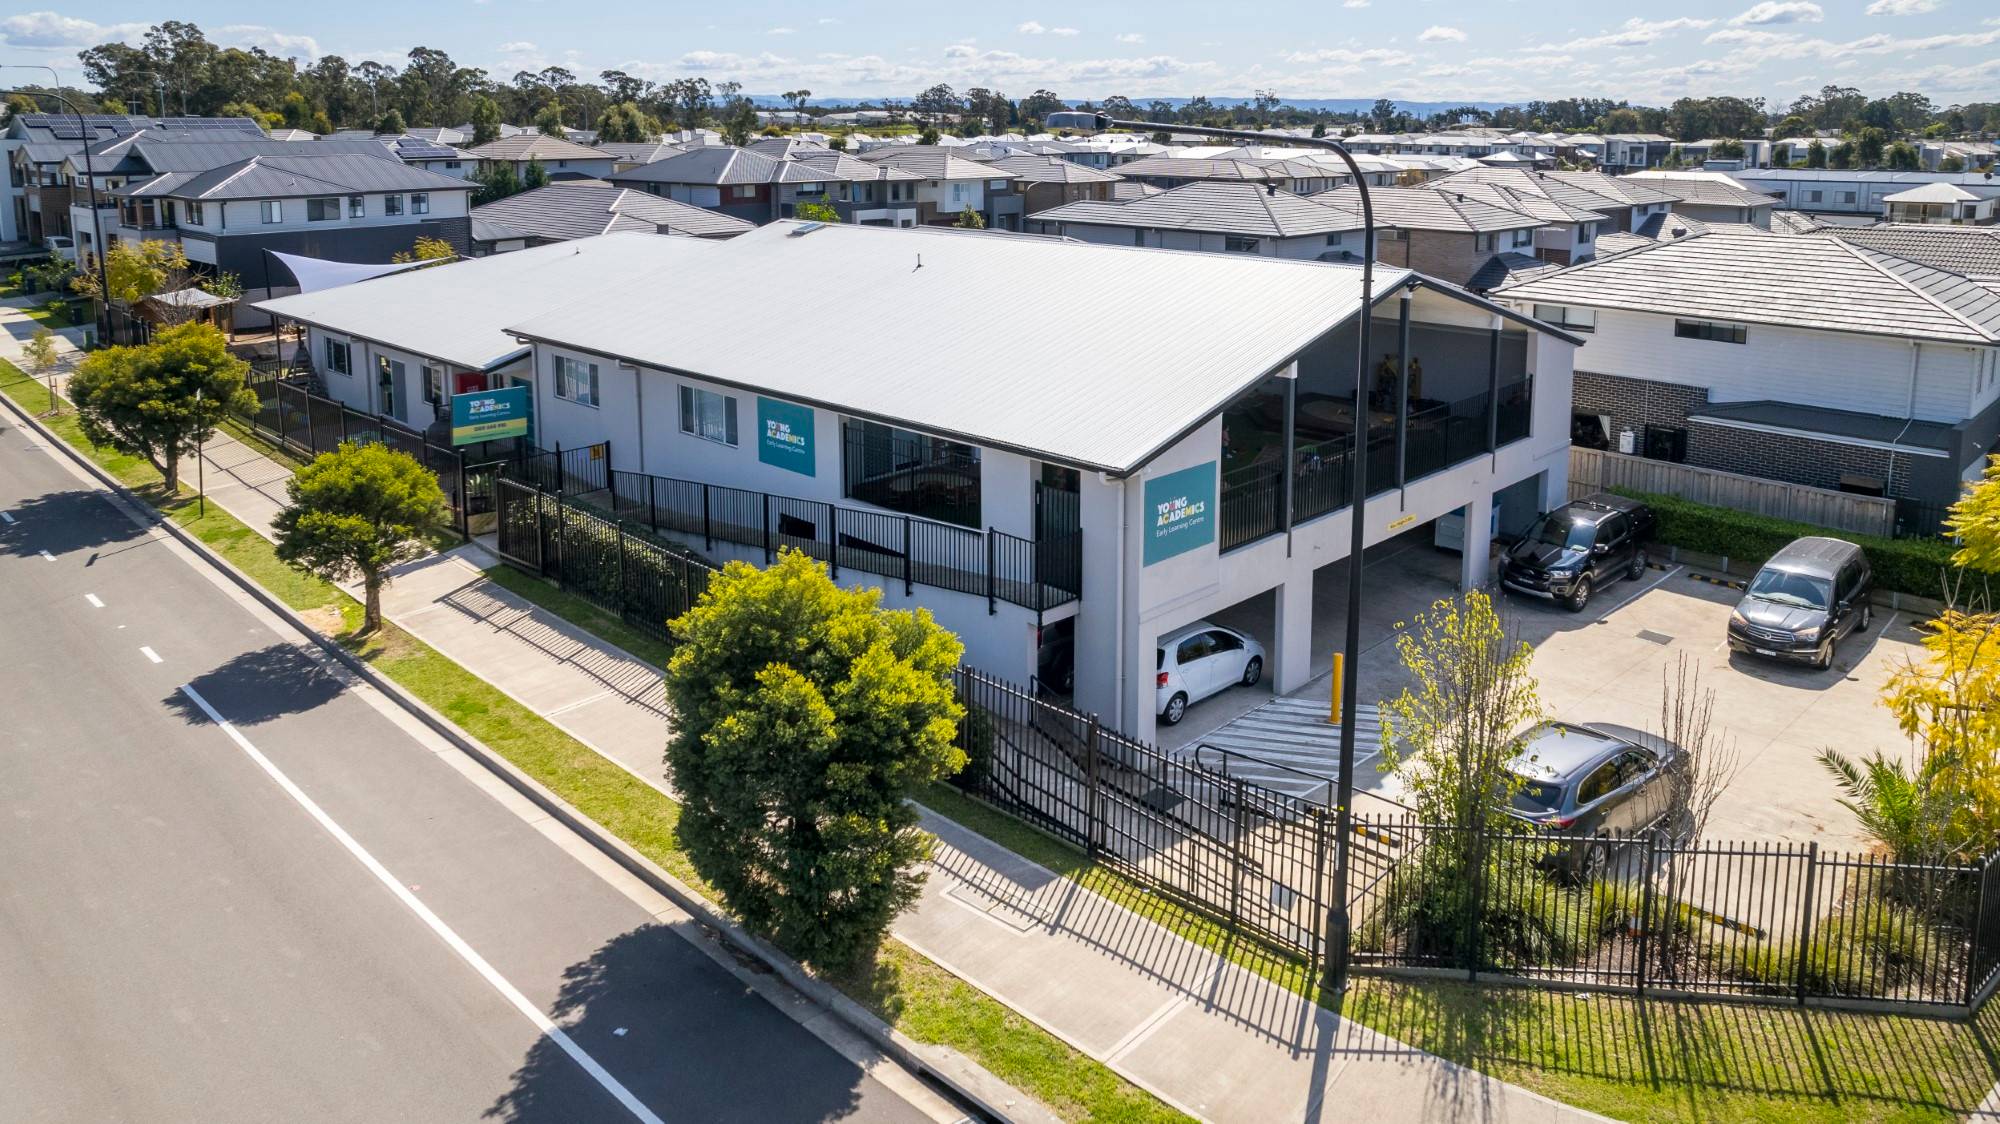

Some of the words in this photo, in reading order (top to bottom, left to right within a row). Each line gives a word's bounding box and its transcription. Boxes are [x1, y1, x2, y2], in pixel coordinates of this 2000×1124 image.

[469, 399, 495, 408] YOUNG
[469, 402, 511, 414] ACADEMICS
[767, 419, 790, 433] YOUNG
[767, 429, 805, 446] ACADEMICS
[1157, 496, 1187, 515] YOUNG
[1157, 501, 1205, 527] ACADEMICS
[1156, 528, 1168, 538] Early
[1168, 521, 1189, 533] Learning
[1189, 516, 1205, 526] Centre
